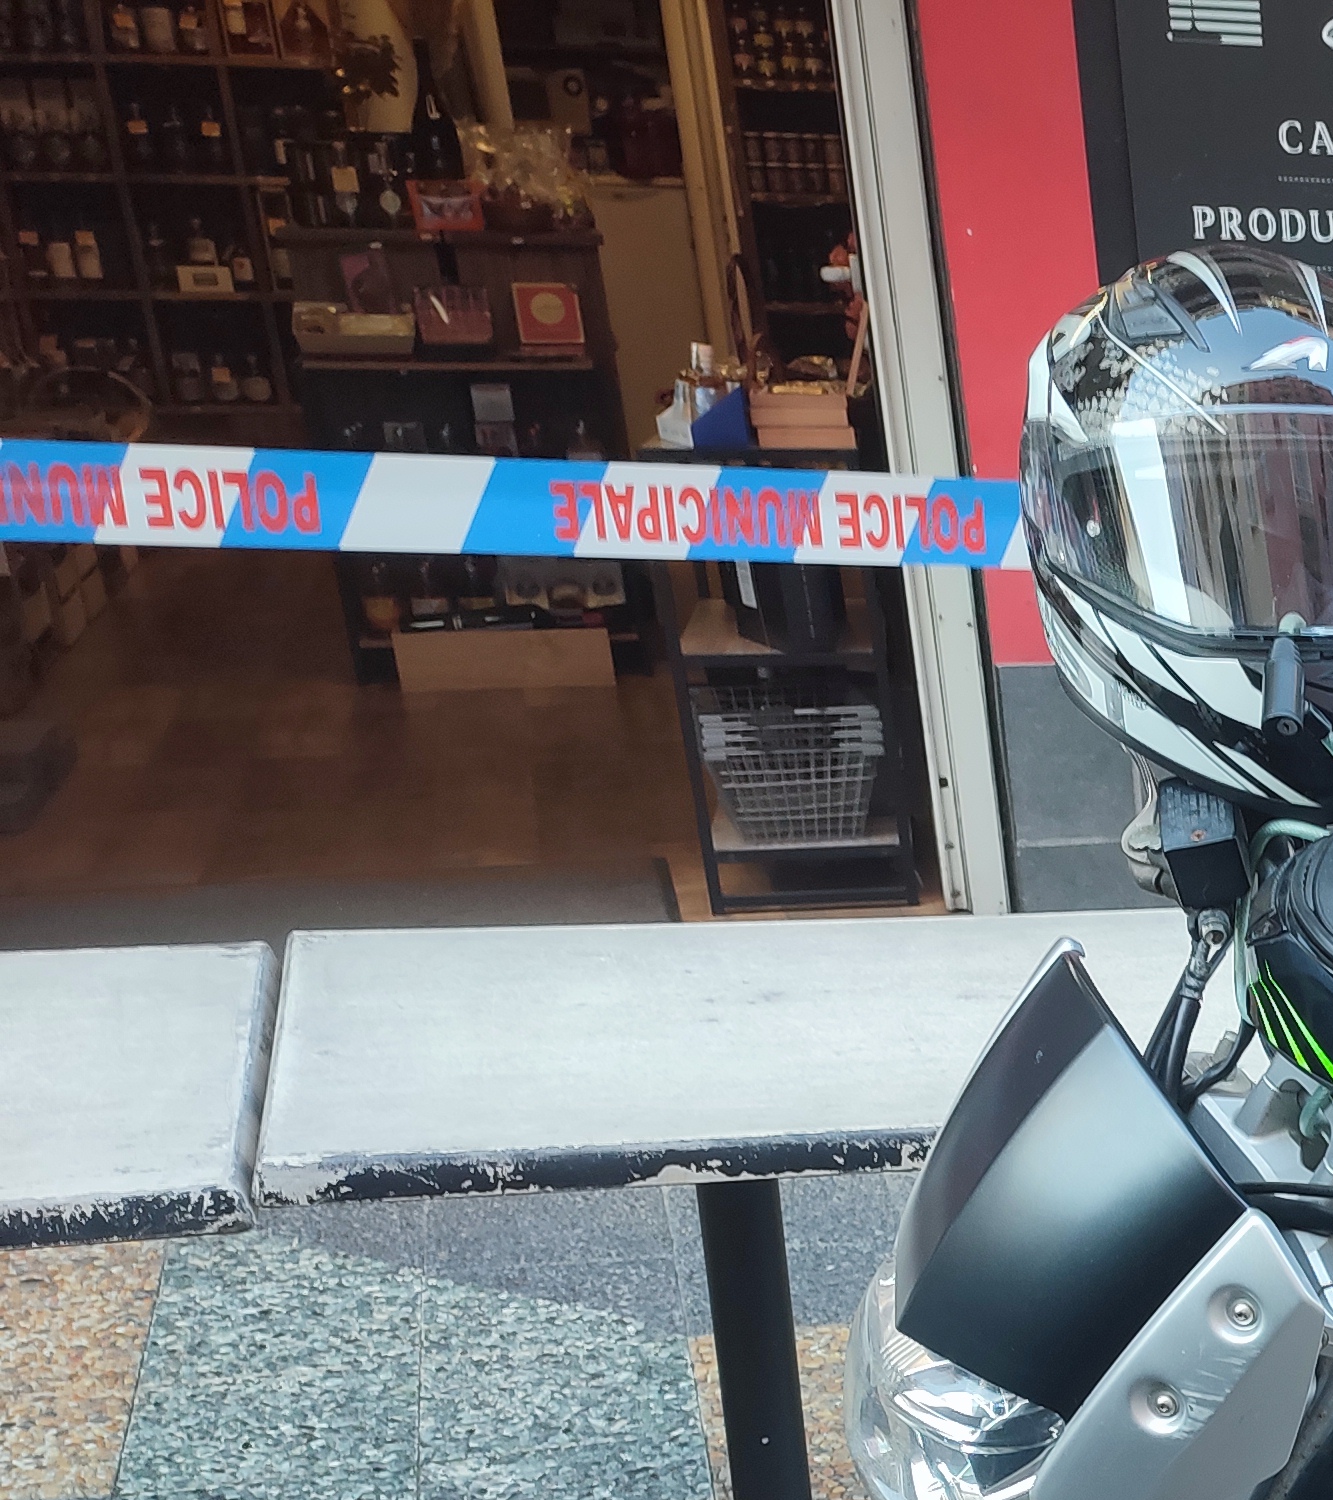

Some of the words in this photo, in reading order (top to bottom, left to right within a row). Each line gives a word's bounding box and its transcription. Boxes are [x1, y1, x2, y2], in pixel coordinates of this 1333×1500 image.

[138, 467, 322, 534] POLICE
[550, 480, 824, 548] MUNICIPALE
[835, 491, 987, 554] POLICE
